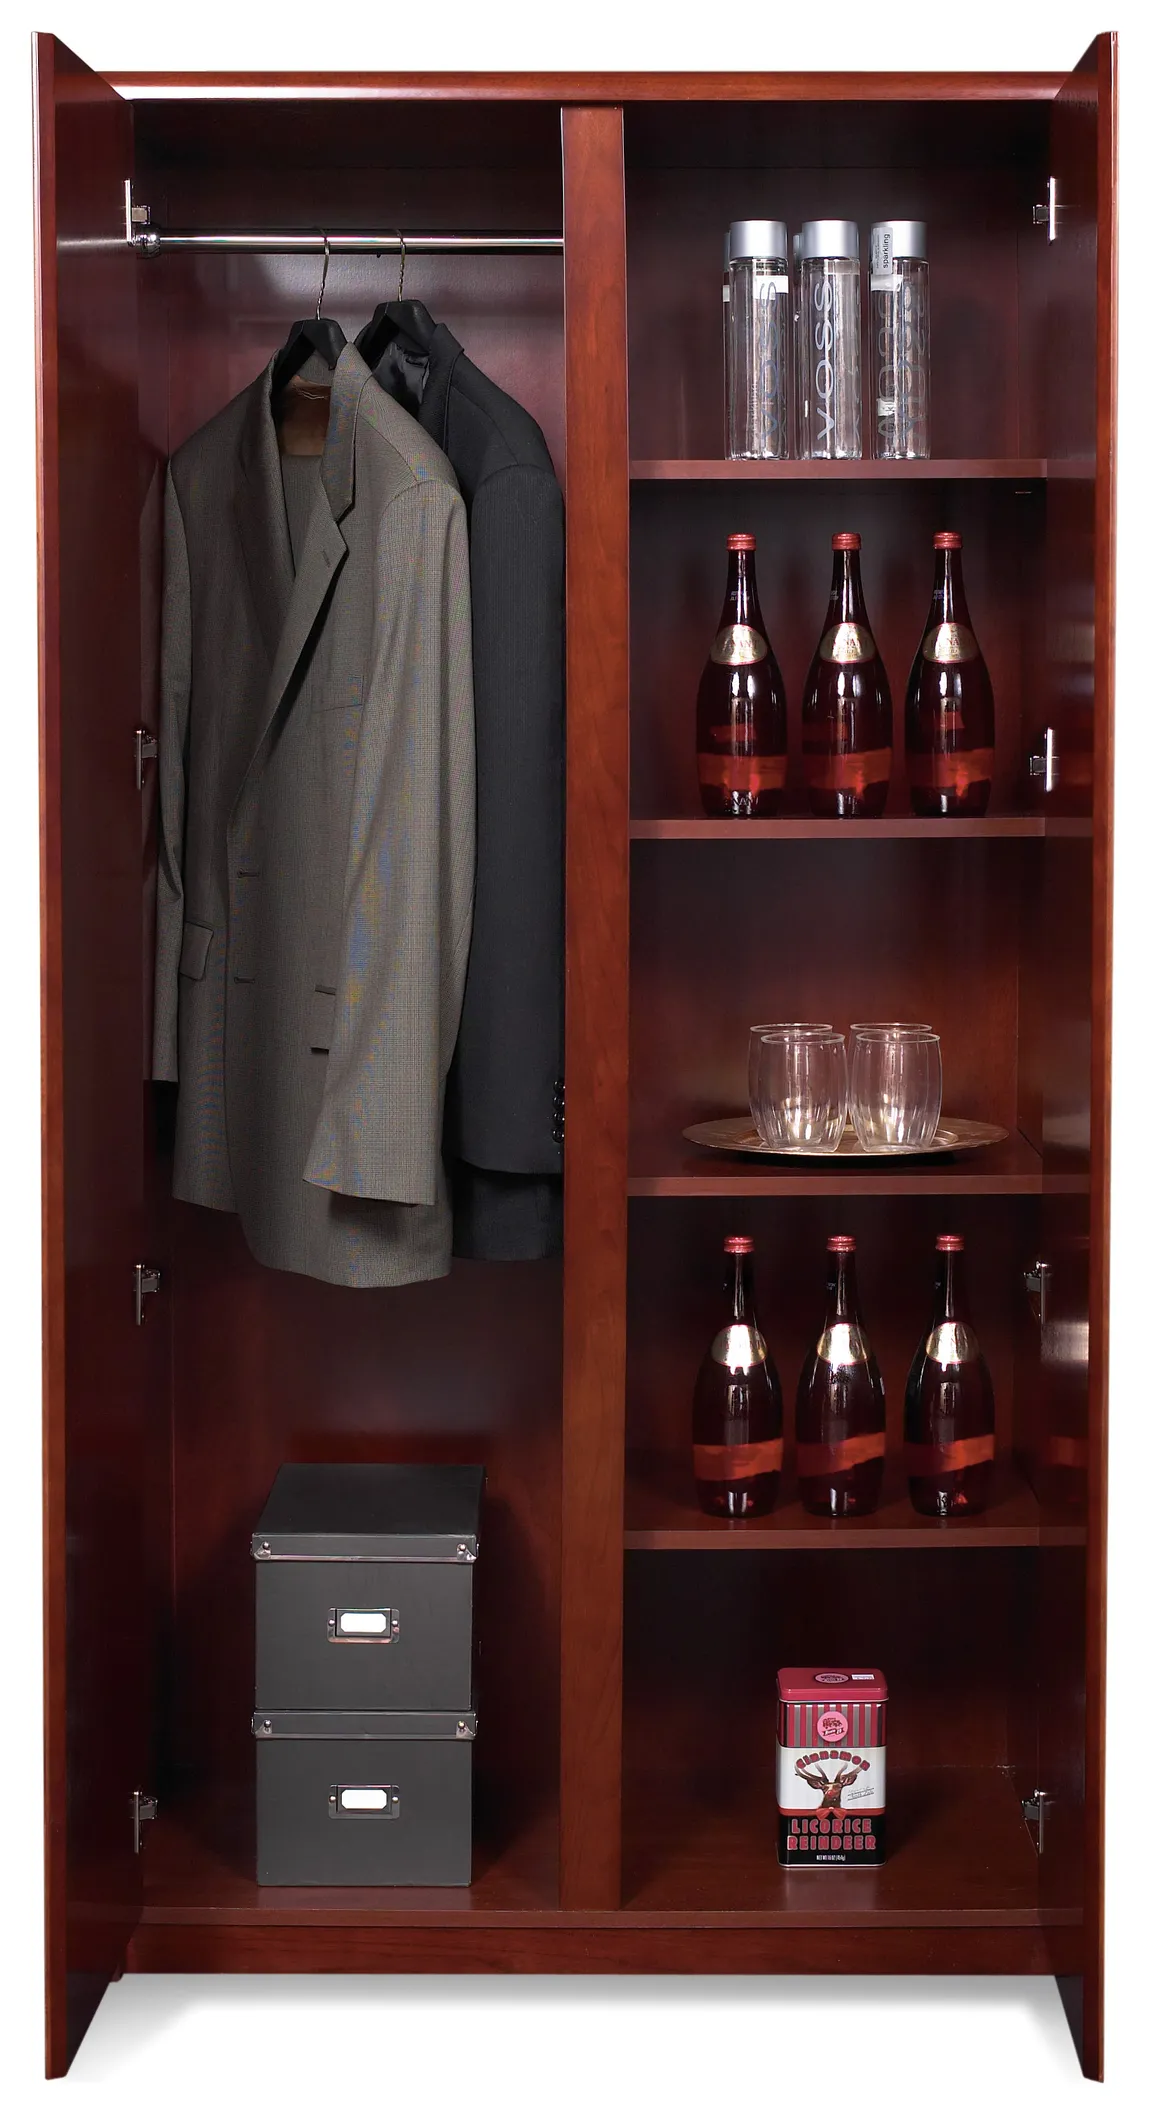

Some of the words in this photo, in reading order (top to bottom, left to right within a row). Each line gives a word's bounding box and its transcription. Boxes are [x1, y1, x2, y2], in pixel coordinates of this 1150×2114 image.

[882, 233, 891, 269] sparkling
[814, 281, 835, 441] VOSS
[791, 1818, 872, 1834] LICORICE
[787, 1835, 876, 1850] REINDEER
